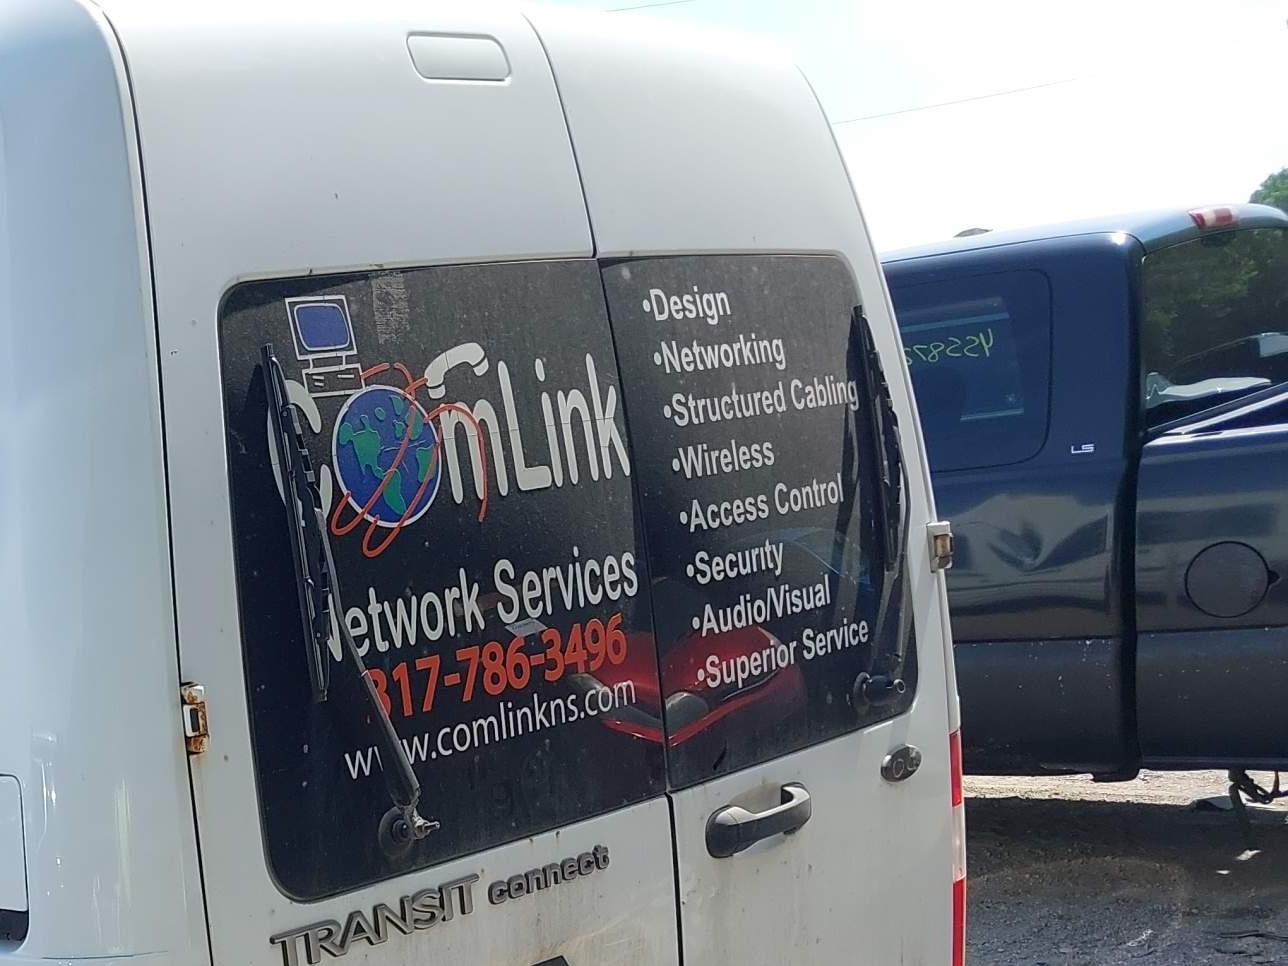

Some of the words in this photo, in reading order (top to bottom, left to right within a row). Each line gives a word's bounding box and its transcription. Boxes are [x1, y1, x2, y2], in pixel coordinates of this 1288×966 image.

[790, 375, 860, 412] Cabling
[1070, 443, 1095, 454] LS
[774, 473, 844, 509] Control
[492, 545, 638, 625] Services
[801, 619, 869, 661] Service
[344, 678, 636, 781] ww.comlinkns.com
[487, 844, 611, 906] connect
